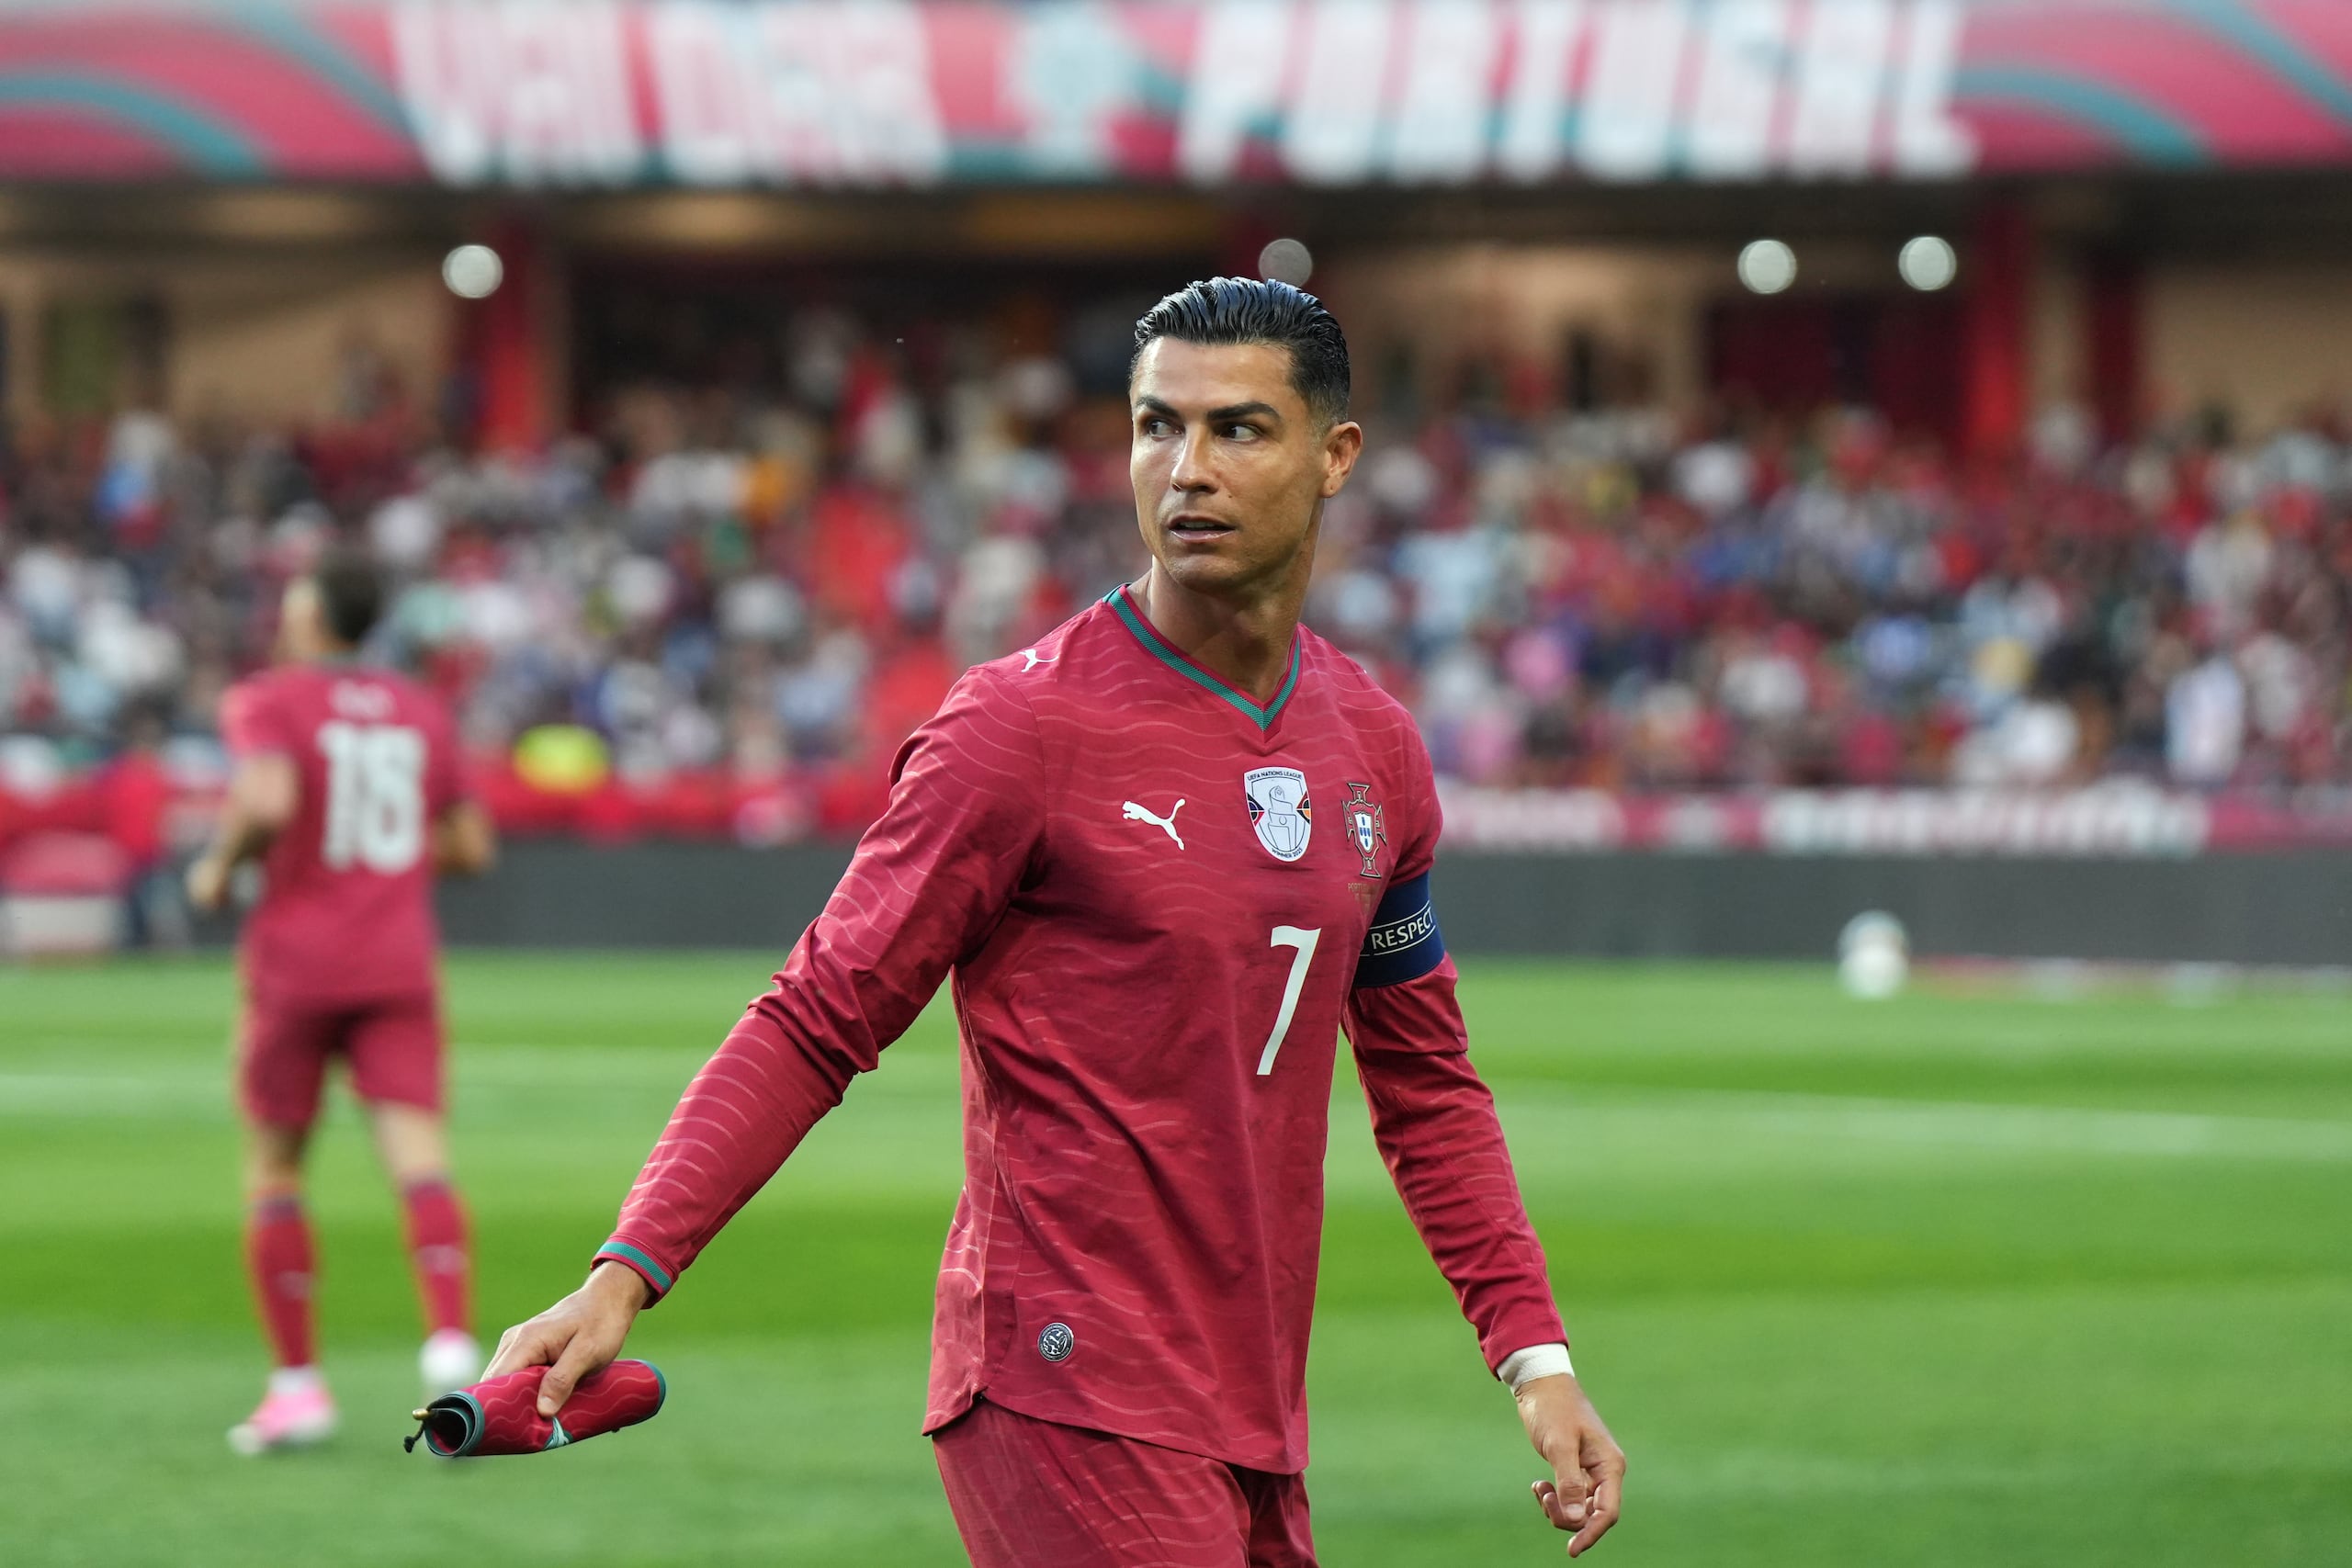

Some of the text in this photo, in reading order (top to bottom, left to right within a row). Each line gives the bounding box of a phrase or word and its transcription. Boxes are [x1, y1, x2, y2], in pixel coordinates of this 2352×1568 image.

[1180, 0, 1977, 184] PORTUGAL
[1247, 773, 1260, 781] UEFA
[1283, 771, 1302, 780] LEAGUE
[1272, 847, 1293, 858] WINNER
[1371, 906, 1432, 950] RESPECT
[1256, 925, 1322, 1076] 7
